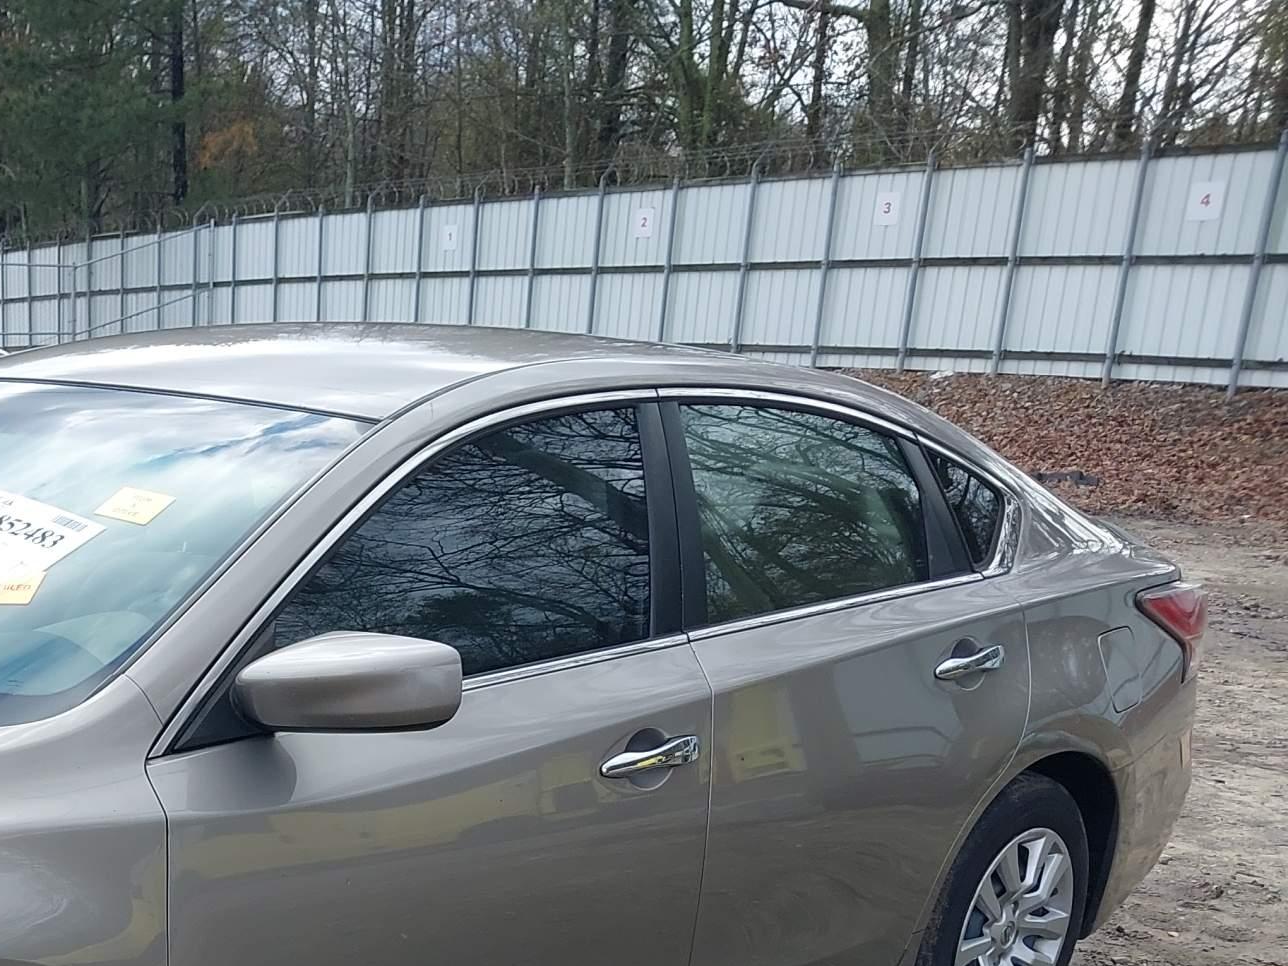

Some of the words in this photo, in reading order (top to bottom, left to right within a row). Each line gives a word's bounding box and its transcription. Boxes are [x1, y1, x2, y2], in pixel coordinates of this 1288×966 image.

[1200, 193, 1212, 207] 4
[882, 202, 892, 214] 3
[640, 217, 648, 228] 2
